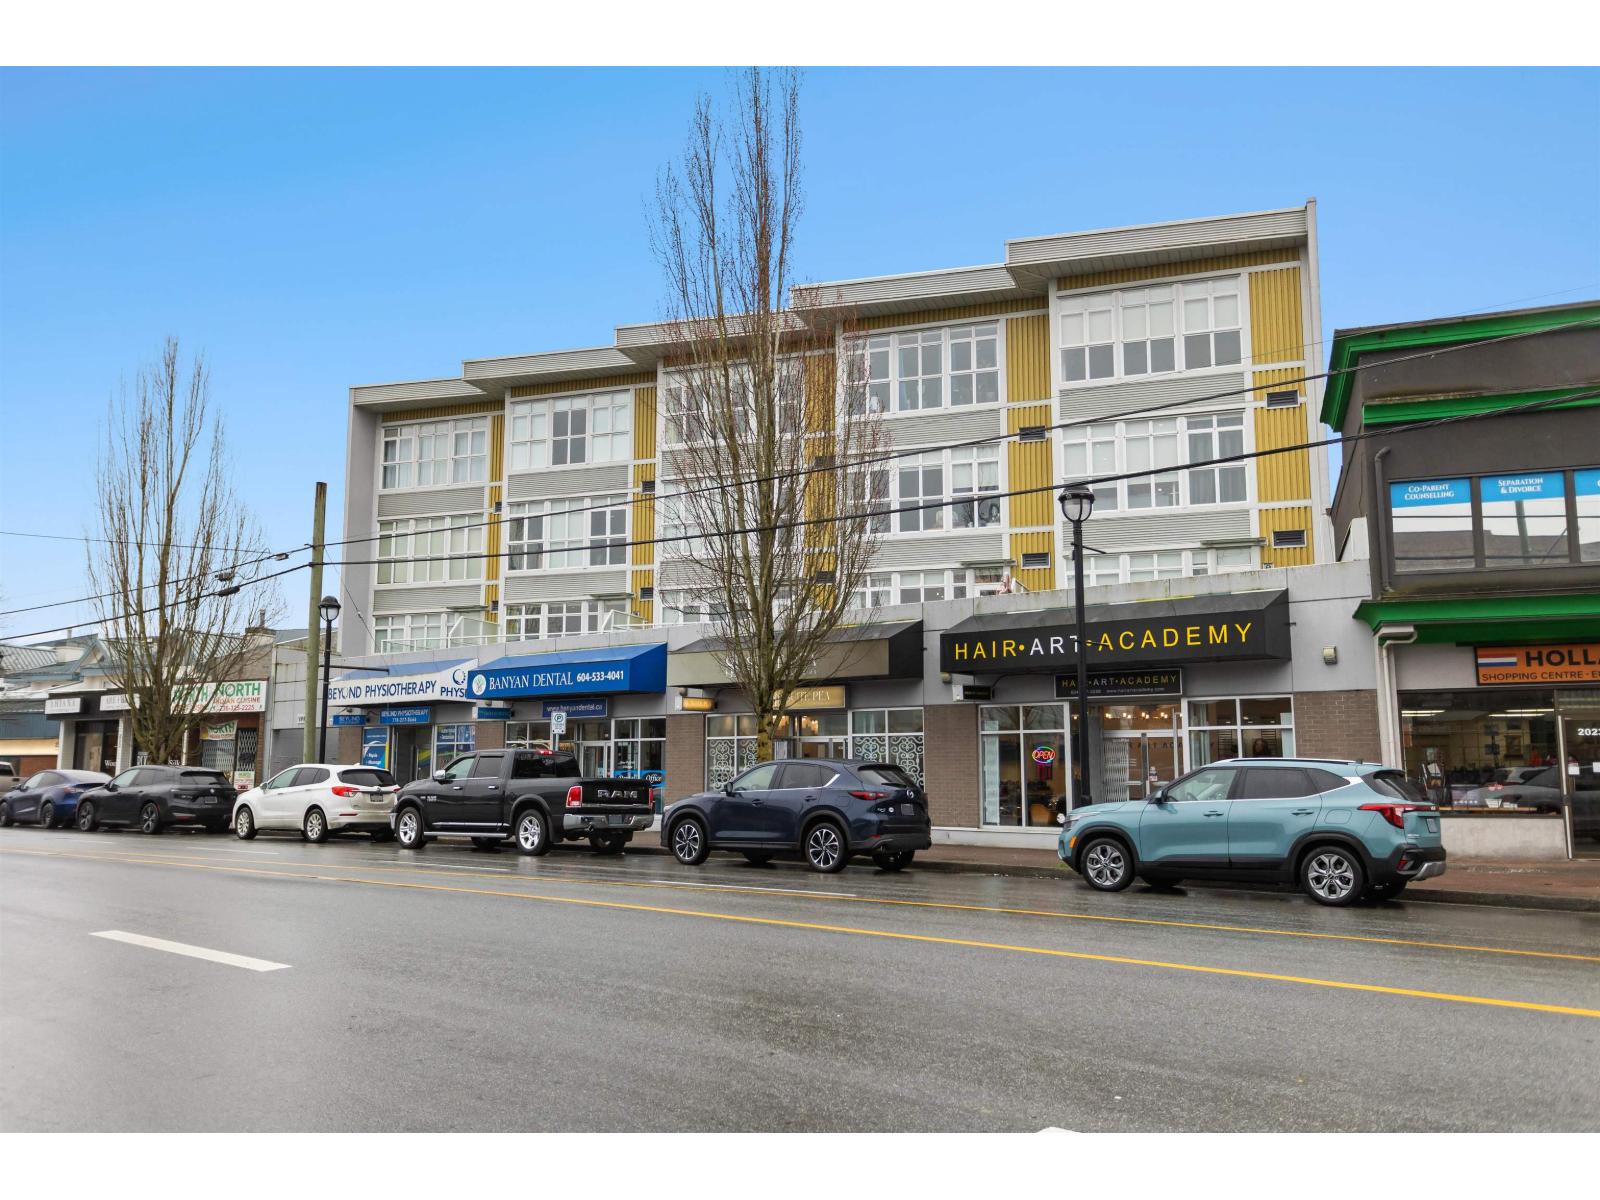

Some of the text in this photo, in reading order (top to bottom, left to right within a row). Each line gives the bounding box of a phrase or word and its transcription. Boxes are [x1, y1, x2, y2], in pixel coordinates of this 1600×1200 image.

[1499, 477, 1543, 487] SEPARATION
[1408, 483, 1450, 493] CO-PARENT
[1508, 485, 1542, 494] DIVORCE
[1404, 491, 1455, 501] COUNSELLING
[955, 639, 1017, 660] HAIR
[1098, 622, 1252, 652] ACADEMY
[1525, 649, 1600, 667] HOLL
[489, 670, 624, 690] BANYAN DENTAL 604-533-4041
[1093, 678, 1114, 686] ART
[1119, 675, 1176, 685] ACADEMY
[1482, 670, 1600, 681] SHOPPING CENTRE E
[328, 680, 437, 700] BEYOND PHYSIOTHERAPY
[1034, 750, 1054, 760] OPEN
[646, 773, 662, 784] Office
[597, 789, 638, 799] RAM
